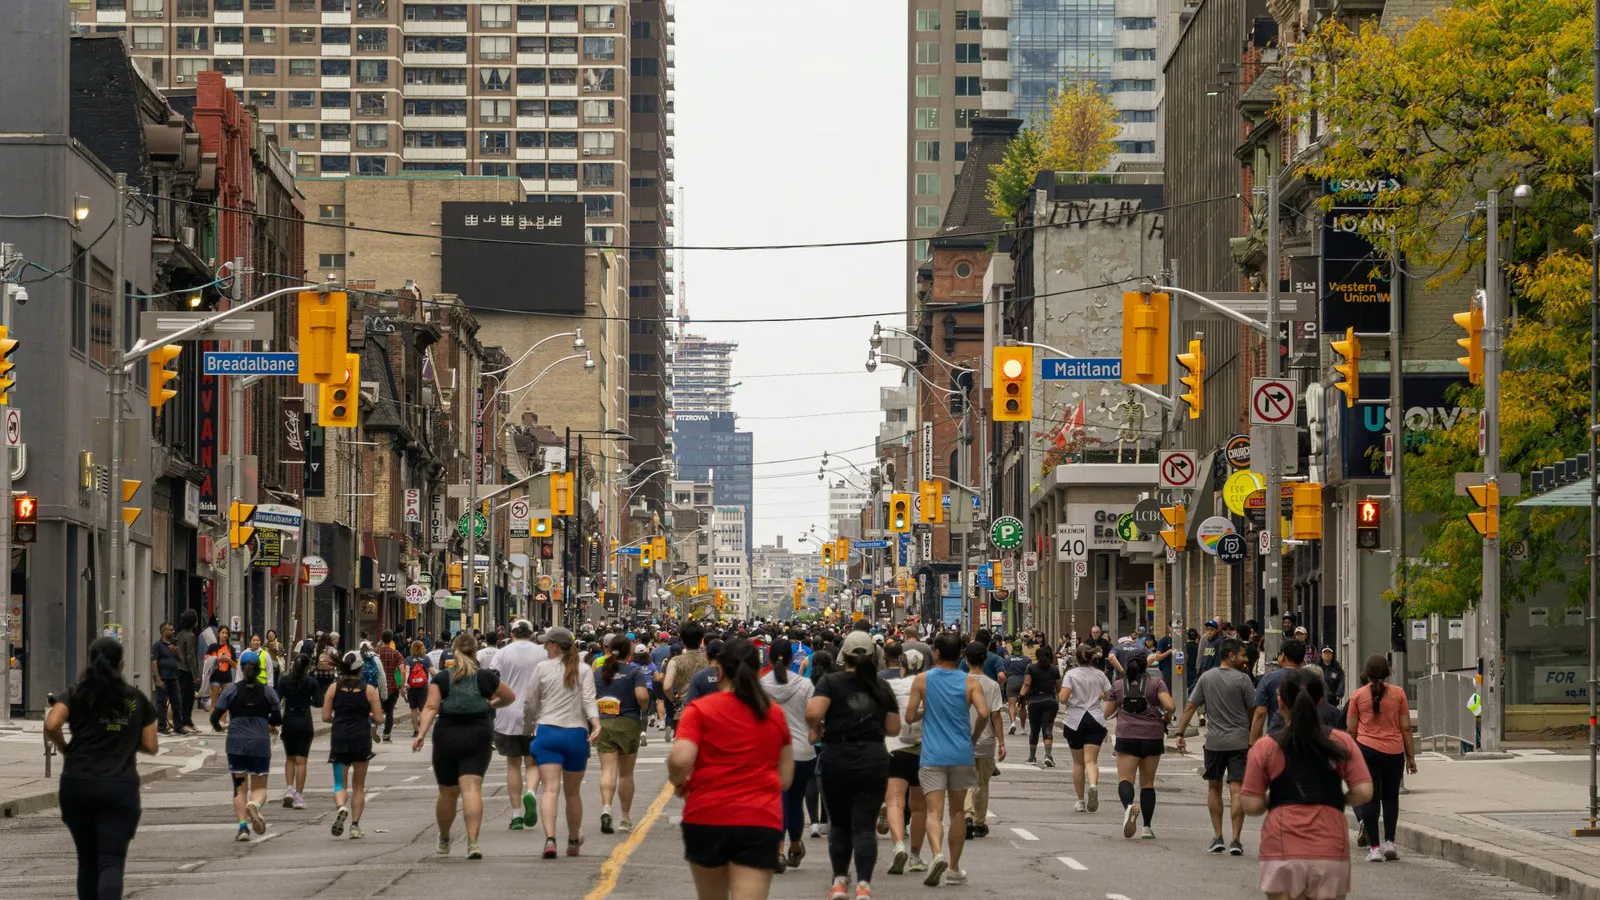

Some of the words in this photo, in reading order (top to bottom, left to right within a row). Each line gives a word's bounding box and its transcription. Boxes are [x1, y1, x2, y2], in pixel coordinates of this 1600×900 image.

[1328, 282, 1376, 292] Western
[1344, 293, 1376, 302] Union
[207, 356, 295, 371] Breadalbane
[1054, 362, 1121, 377] Maitland
[406, 490, 418, 516] SPA
[1160, 493, 1192, 504] LCO
[1231, 494, 1248, 503] CLU
[255, 513, 292, 524] Breadalbane
[293, 517, 299, 525] St
[1094, 510, 1123, 522] Go
[1001, 525, 1014, 539] P
[1060, 540, 1085, 556] 40
[406, 588, 422, 597] SPA
[1545, 671, 1576, 684] FOR
[1565, 688, 1586, 698] sq.ft
